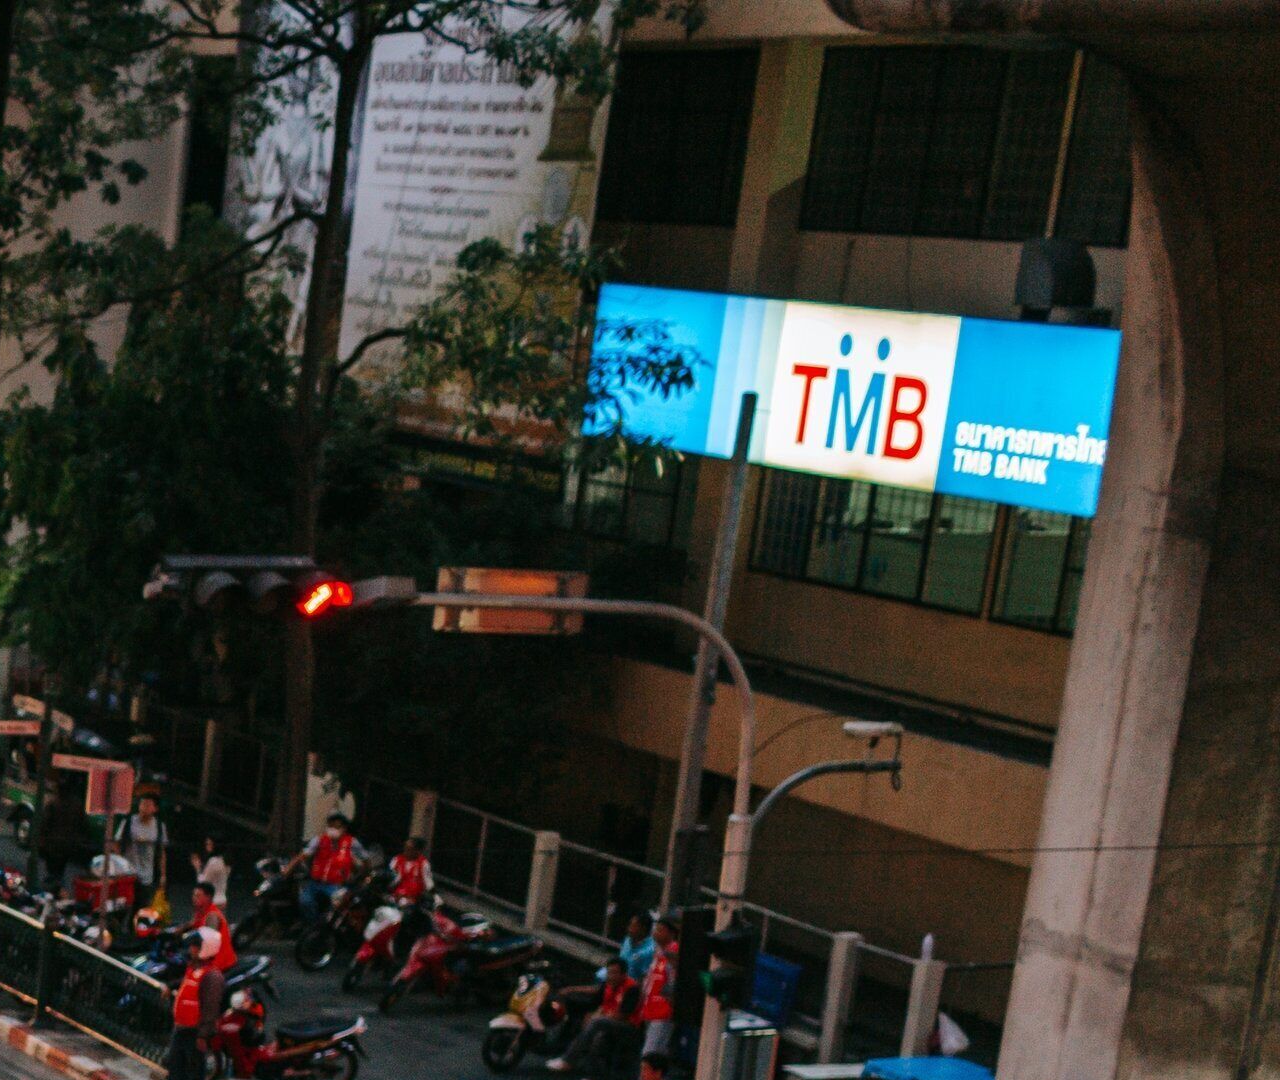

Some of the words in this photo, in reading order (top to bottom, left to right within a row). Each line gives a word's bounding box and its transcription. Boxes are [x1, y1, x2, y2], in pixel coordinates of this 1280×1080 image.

[792, 363, 928, 461] TMB
[952, 447, 993, 477] TMB
[994, 452, 1050, 485] BANK
